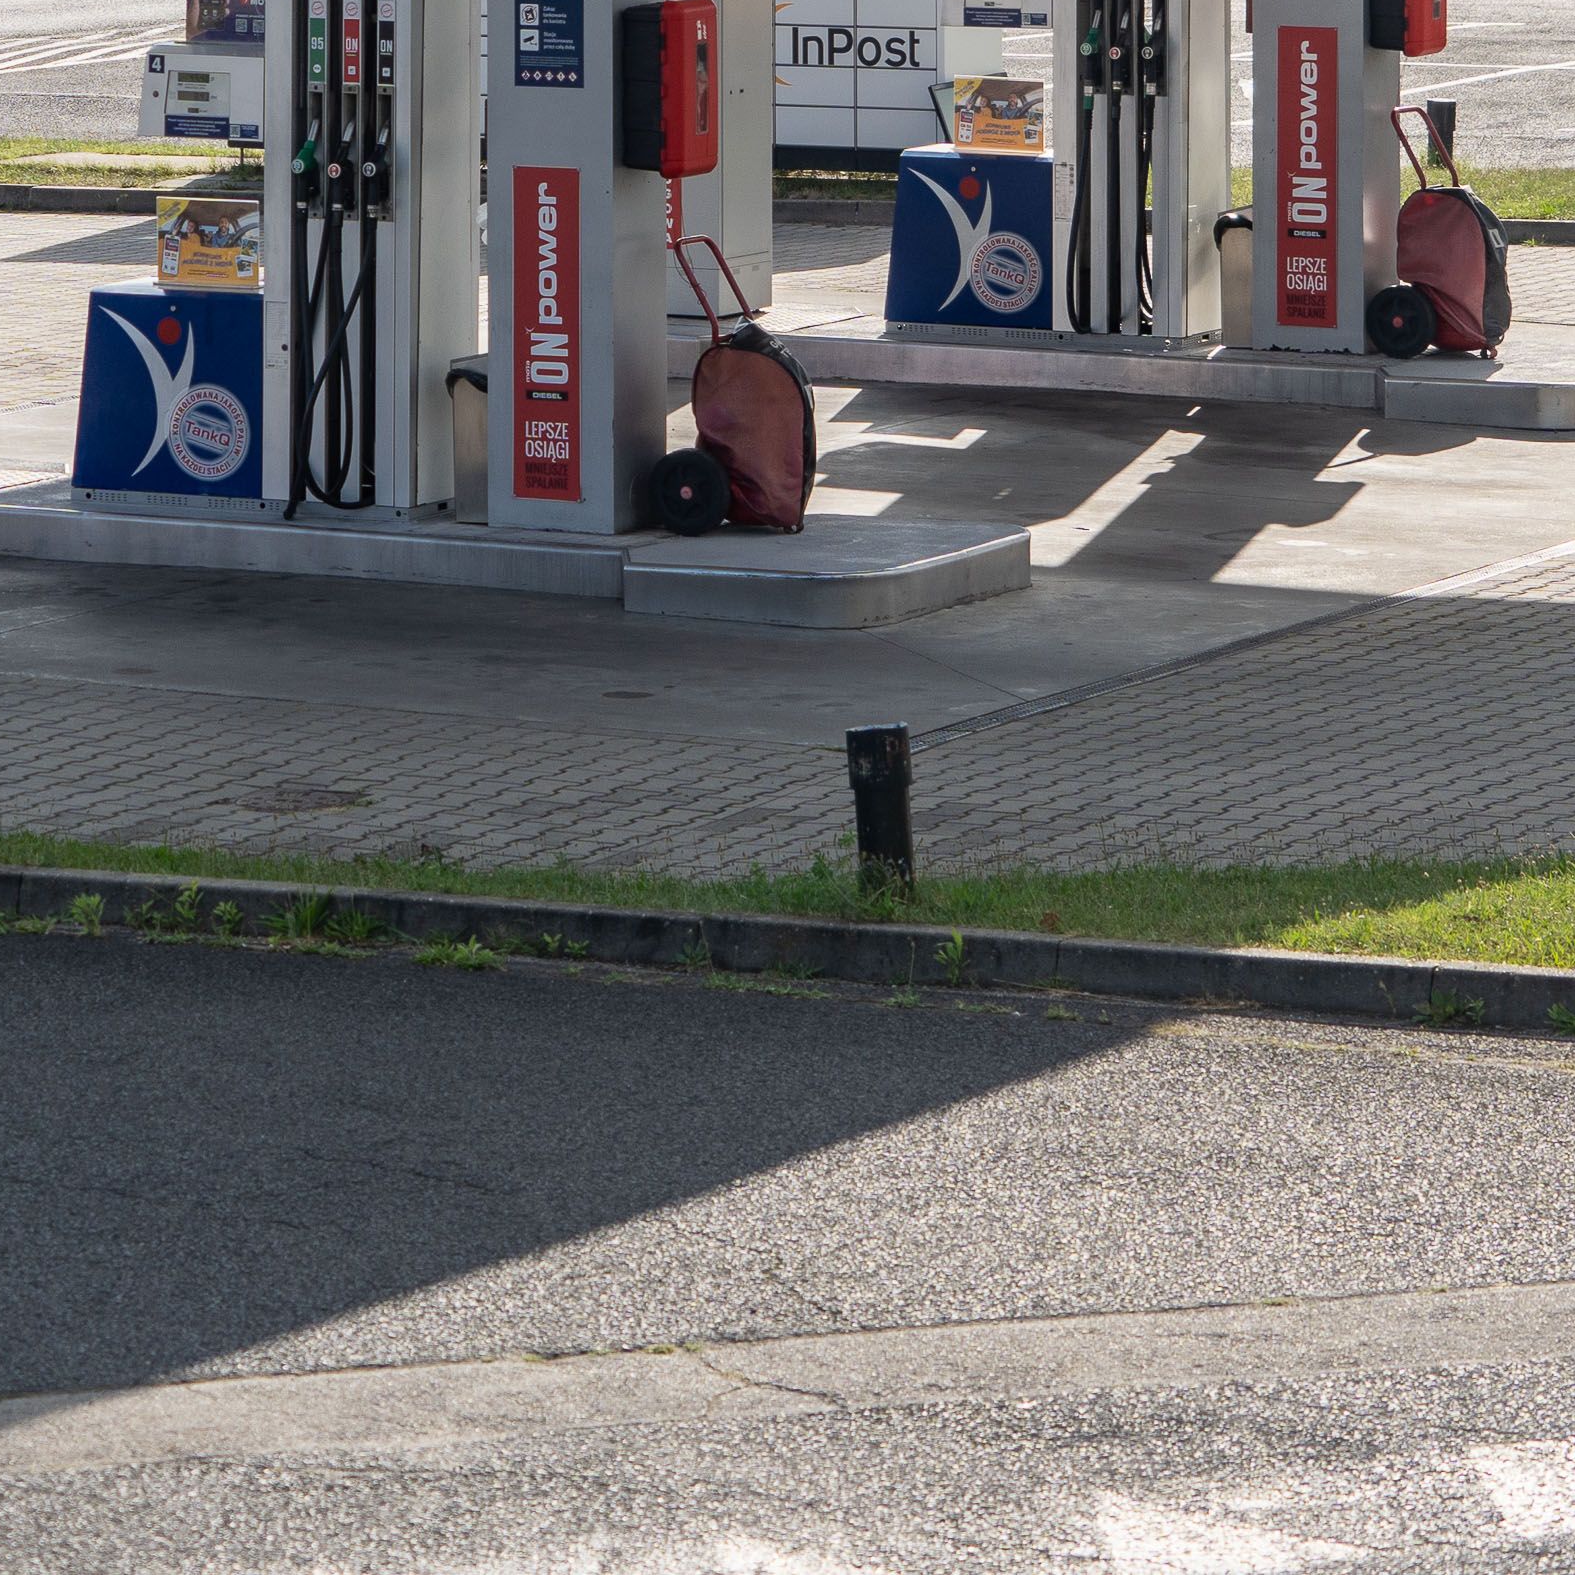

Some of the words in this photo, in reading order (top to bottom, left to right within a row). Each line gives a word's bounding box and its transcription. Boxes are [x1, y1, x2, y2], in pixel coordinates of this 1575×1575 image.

[311, 37, 324, 50] 95
[345, 37, 359, 51] ON
[379, 39, 393, 52] ON
[791, 26, 921, 68] InPost
[151, 57, 162, 72] 4
[1300, 40, 1323, 170] power
[1292, 176, 1328, 225] ON
[1293, 230, 1321, 238] DIESEL
[537, 181, 562, 325] power
[985, 260, 1025, 285] TankQ
[1286, 256, 1327, 274] LEPSZE
[1286, 273, 1327, 294] OSIĄGI
[530, 332, 569, 385] ON
[532, 391, 563, 400] DIESEL
[171, 391, 219, 436] KONTROLOWANA
[185, 420, 231, 447] TankQ
[525, 421, 569, 440] LEPSZE
[525, 439, 569, 463] OSIĄGI
